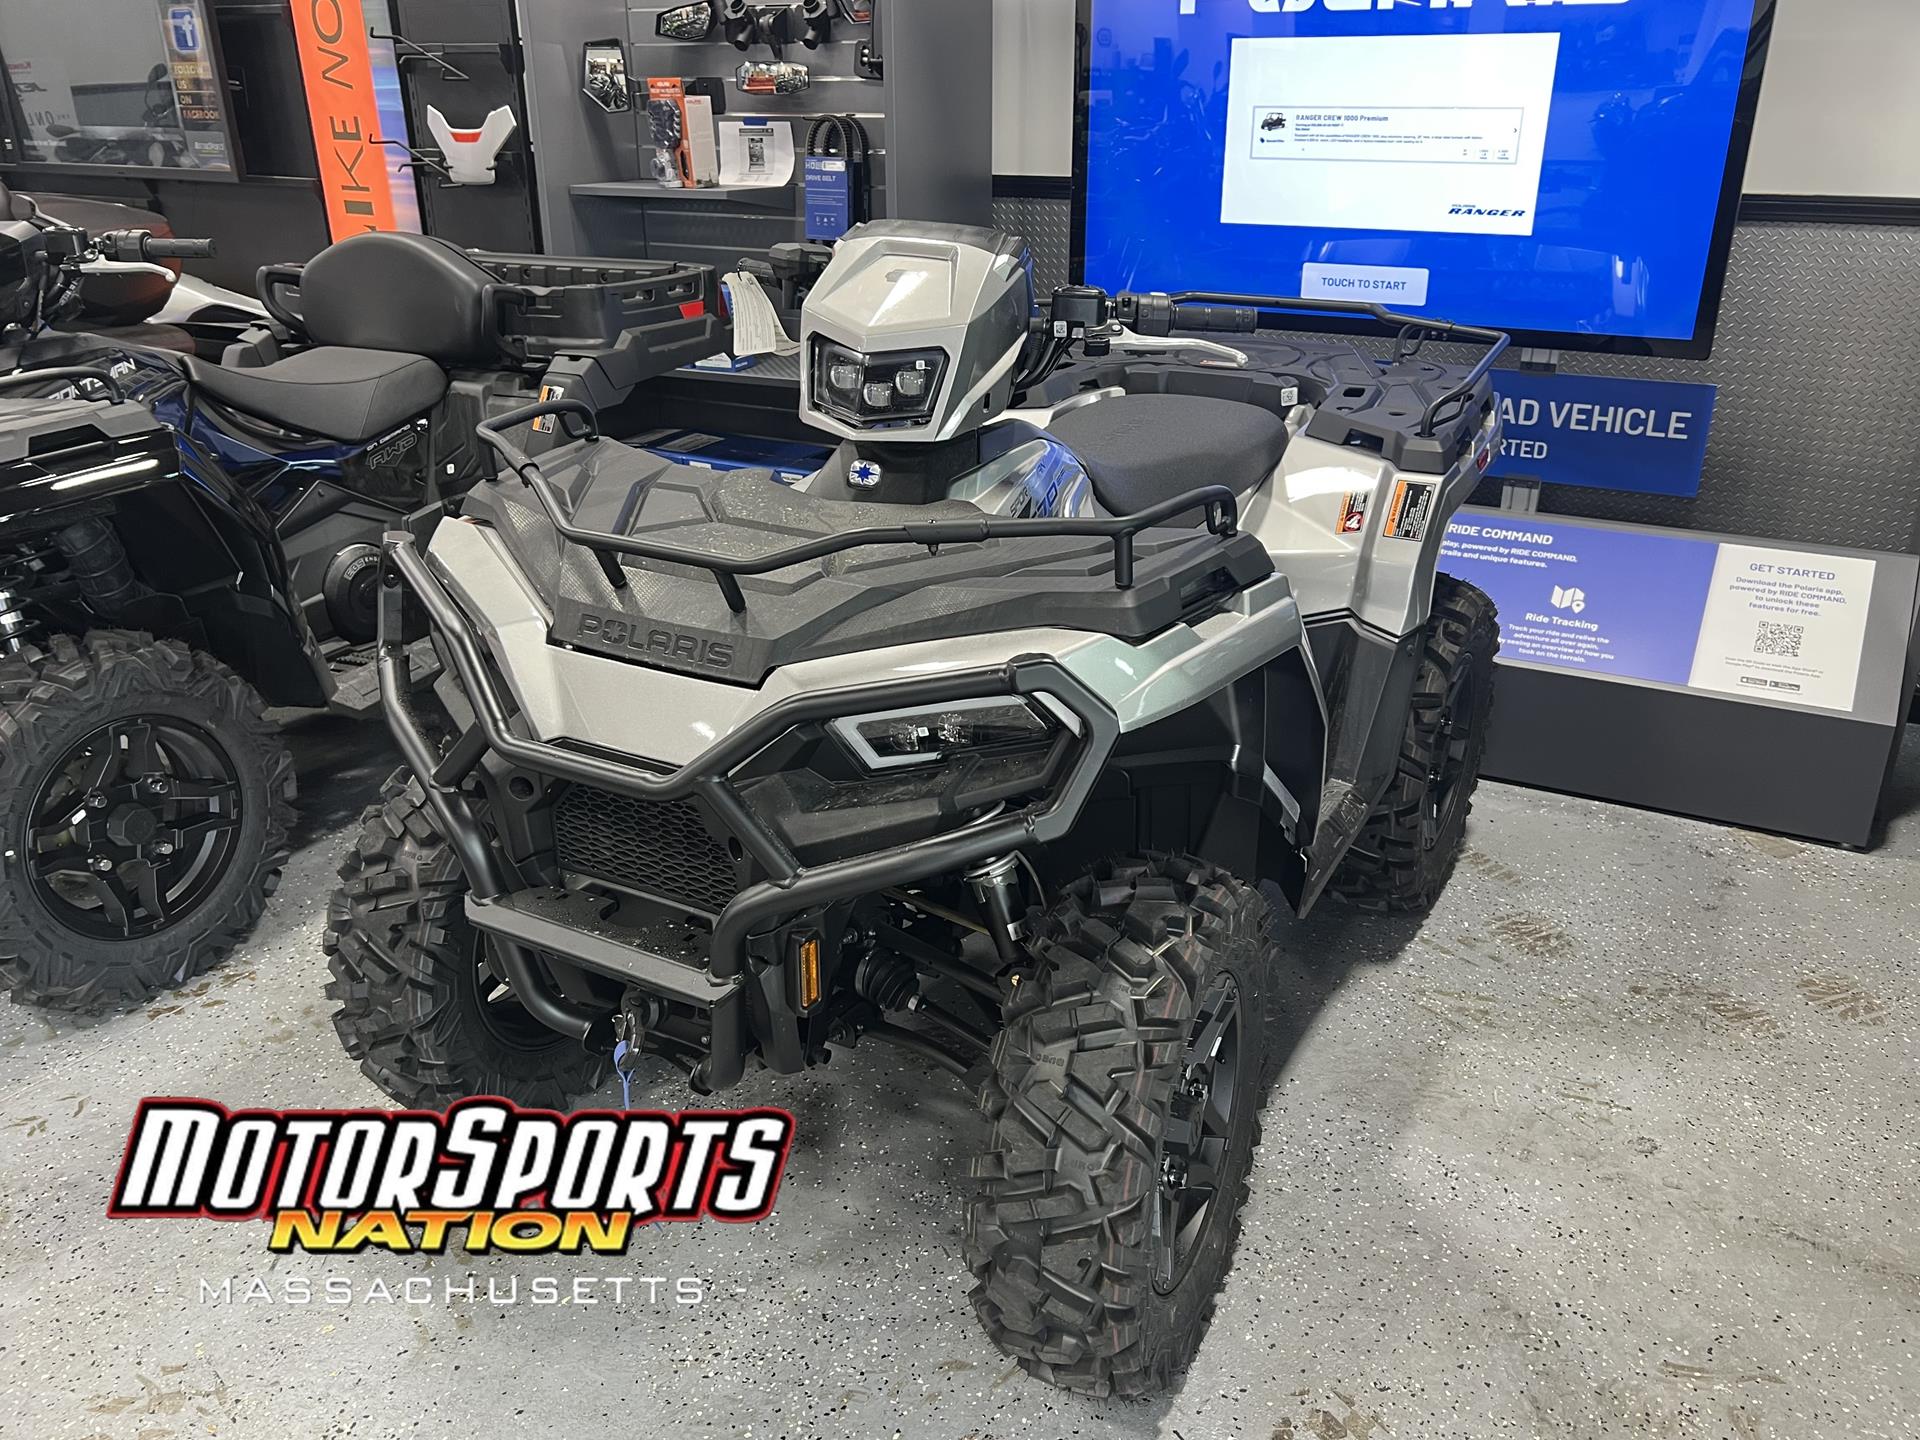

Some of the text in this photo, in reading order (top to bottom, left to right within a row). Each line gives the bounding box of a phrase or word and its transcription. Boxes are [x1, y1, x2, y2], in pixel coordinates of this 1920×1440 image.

[329, 116, 377, 233] IKE
[1448, 207, 1526, 217] RANGER
[1321, 277, 1407, 290] TOUCH TO START
[1549, 401, 1692, 440] VEHICLE
[1448, 523, 1553, 545] RIDE COMMAND
[1461, 541, 1498, 553] powered
[1499, 544, 1510, 555] by
[1510, 547, 1531, 556] RIDE
[1440, 549, 1548, 568] trails and unique features.
[1749, 563, 1836, 581] GET STARTED
[1729, 584, 1766, 594] powered
[1767, 588, 1778, 596] by
[1779, 590, 1799, 598] RIDE
[1736, 576, 1777, 587] Download
[1779, 581, 1793, 589] the
[1794, 583, 1824, 593] Polaris
[1749, 602, 1821, 617] features for free.
[1765, 596, 1794, 605] unlock
[1795, 600, 1820, 609] these
[1525, 612, 1599, 632] Ride Tracking
[577, 613, 734, 668] POLARIS
[1508, 623, 1609, 644] Track your ride and relive the
[1513, 632, 1550, 642] adventure
[1560, 638, 1577, 646] over
[1507, 639, 1531, 648] seeing
[1541, 644, 1574, 653] overview
[1601, 652, 1614, 660] you
[1518, 647, 1535, 655] took
[1546, 651, 1559, 659] the
